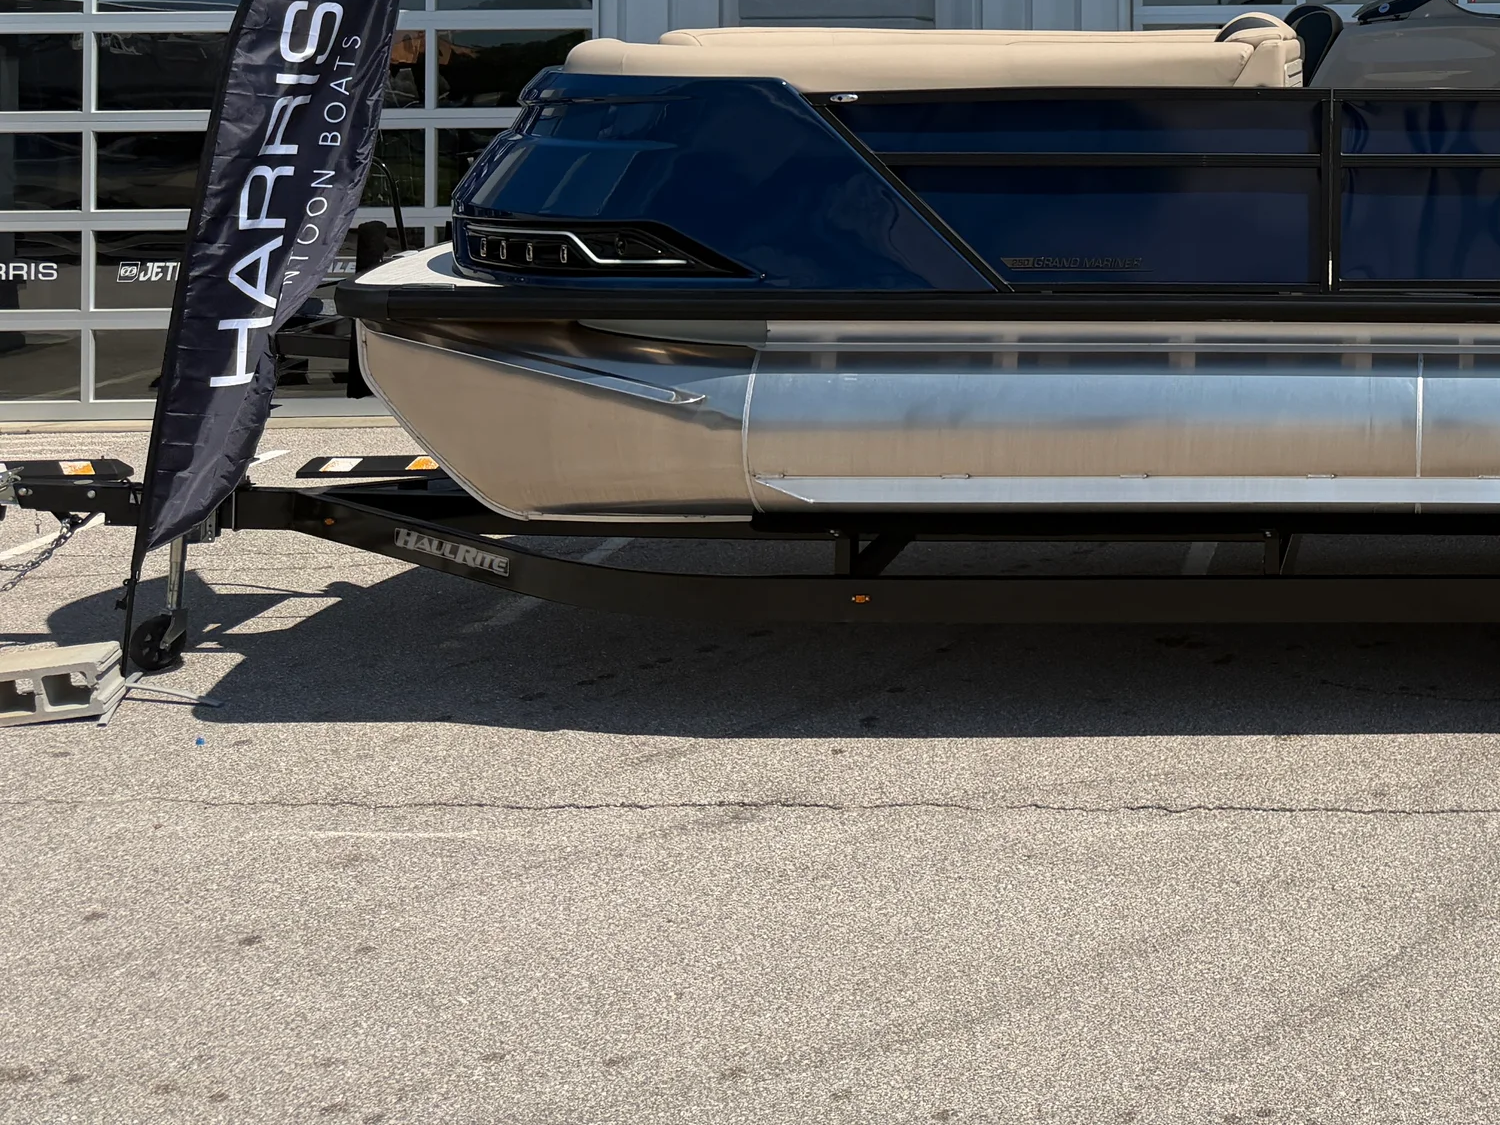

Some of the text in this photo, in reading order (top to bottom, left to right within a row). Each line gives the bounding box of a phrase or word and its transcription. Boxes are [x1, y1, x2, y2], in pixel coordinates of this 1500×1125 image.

[318, 34, 361, 147] BOATS
[209, 0, 344, 388] HARRIS
[1033, 256, 1080, 268] GRAND
[1083, 256, 1143, 268] MARINER
